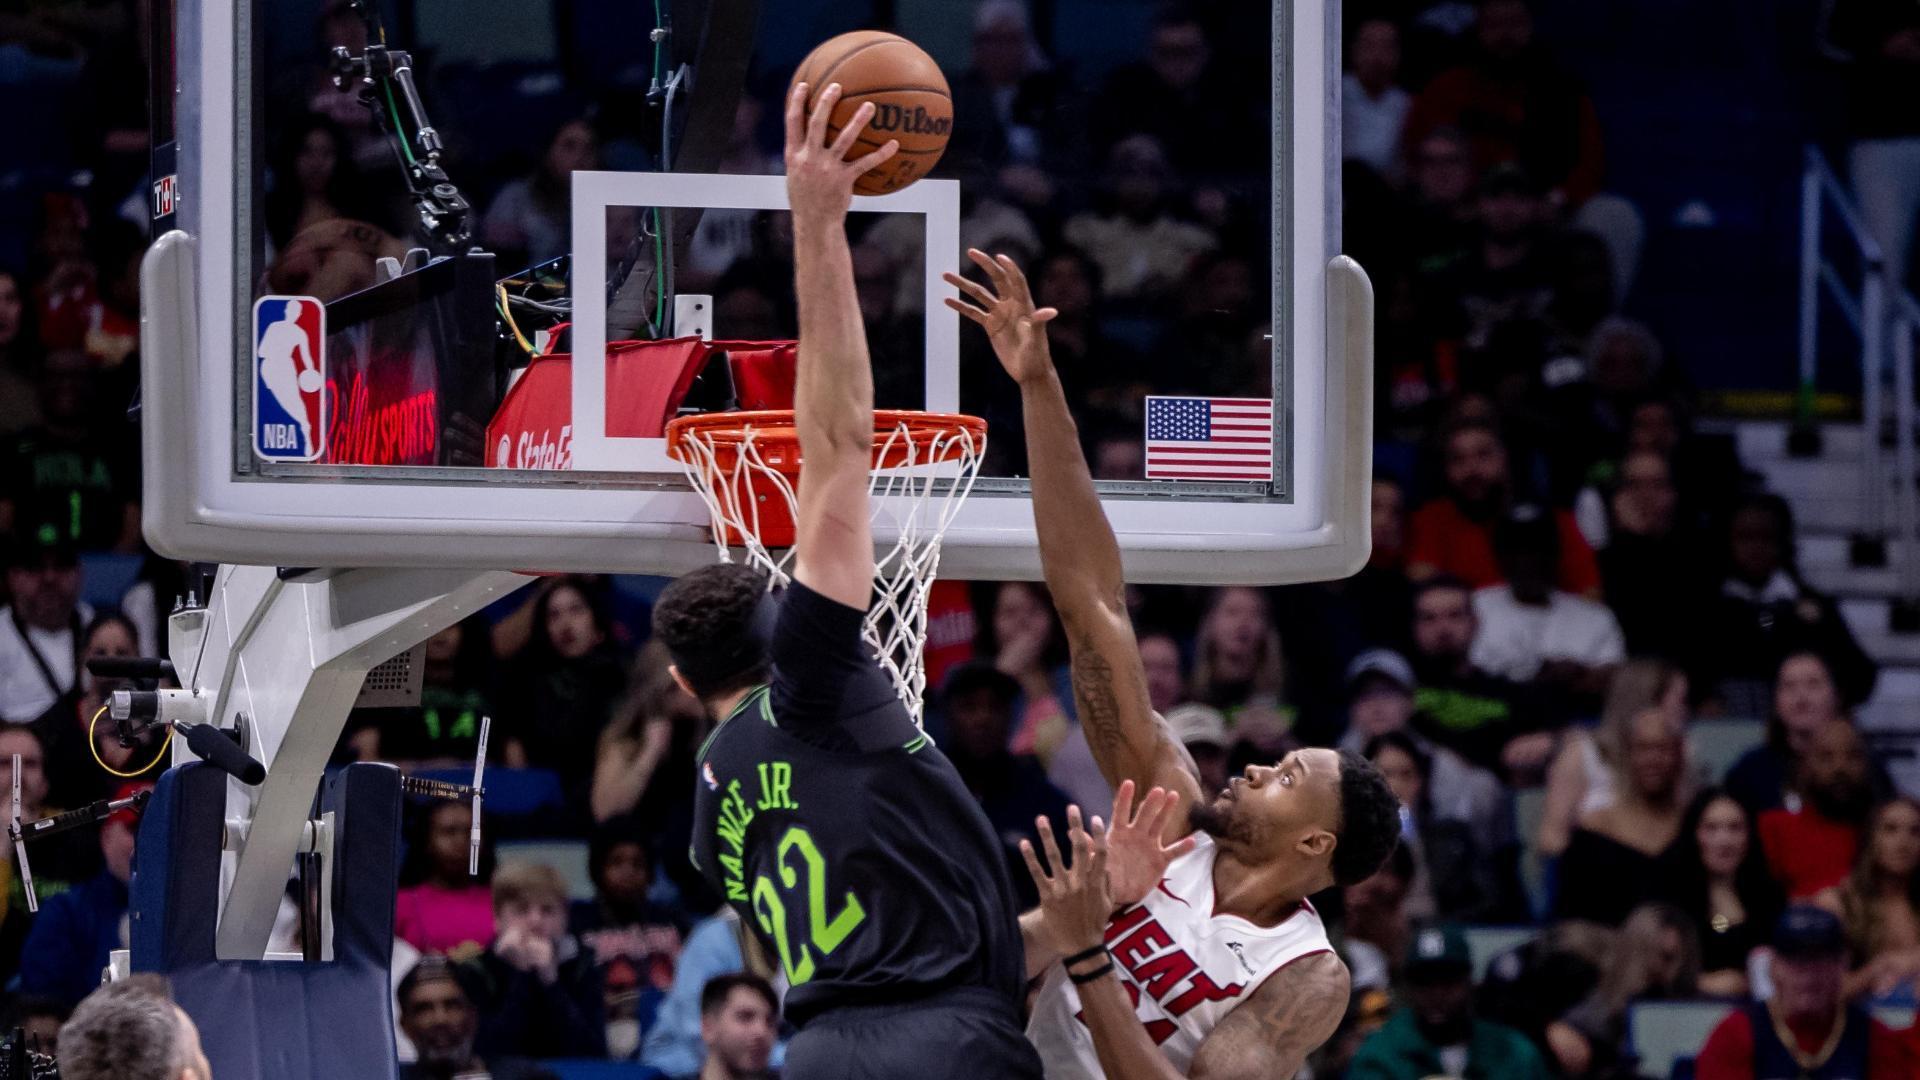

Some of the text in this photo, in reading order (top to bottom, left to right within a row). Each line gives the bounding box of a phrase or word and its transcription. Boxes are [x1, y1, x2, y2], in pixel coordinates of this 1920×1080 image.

[263, 423, 298, 449] NBA
[717, 761, 799, 901] NANCE JR.
[753, 827, 866, 986] 22
